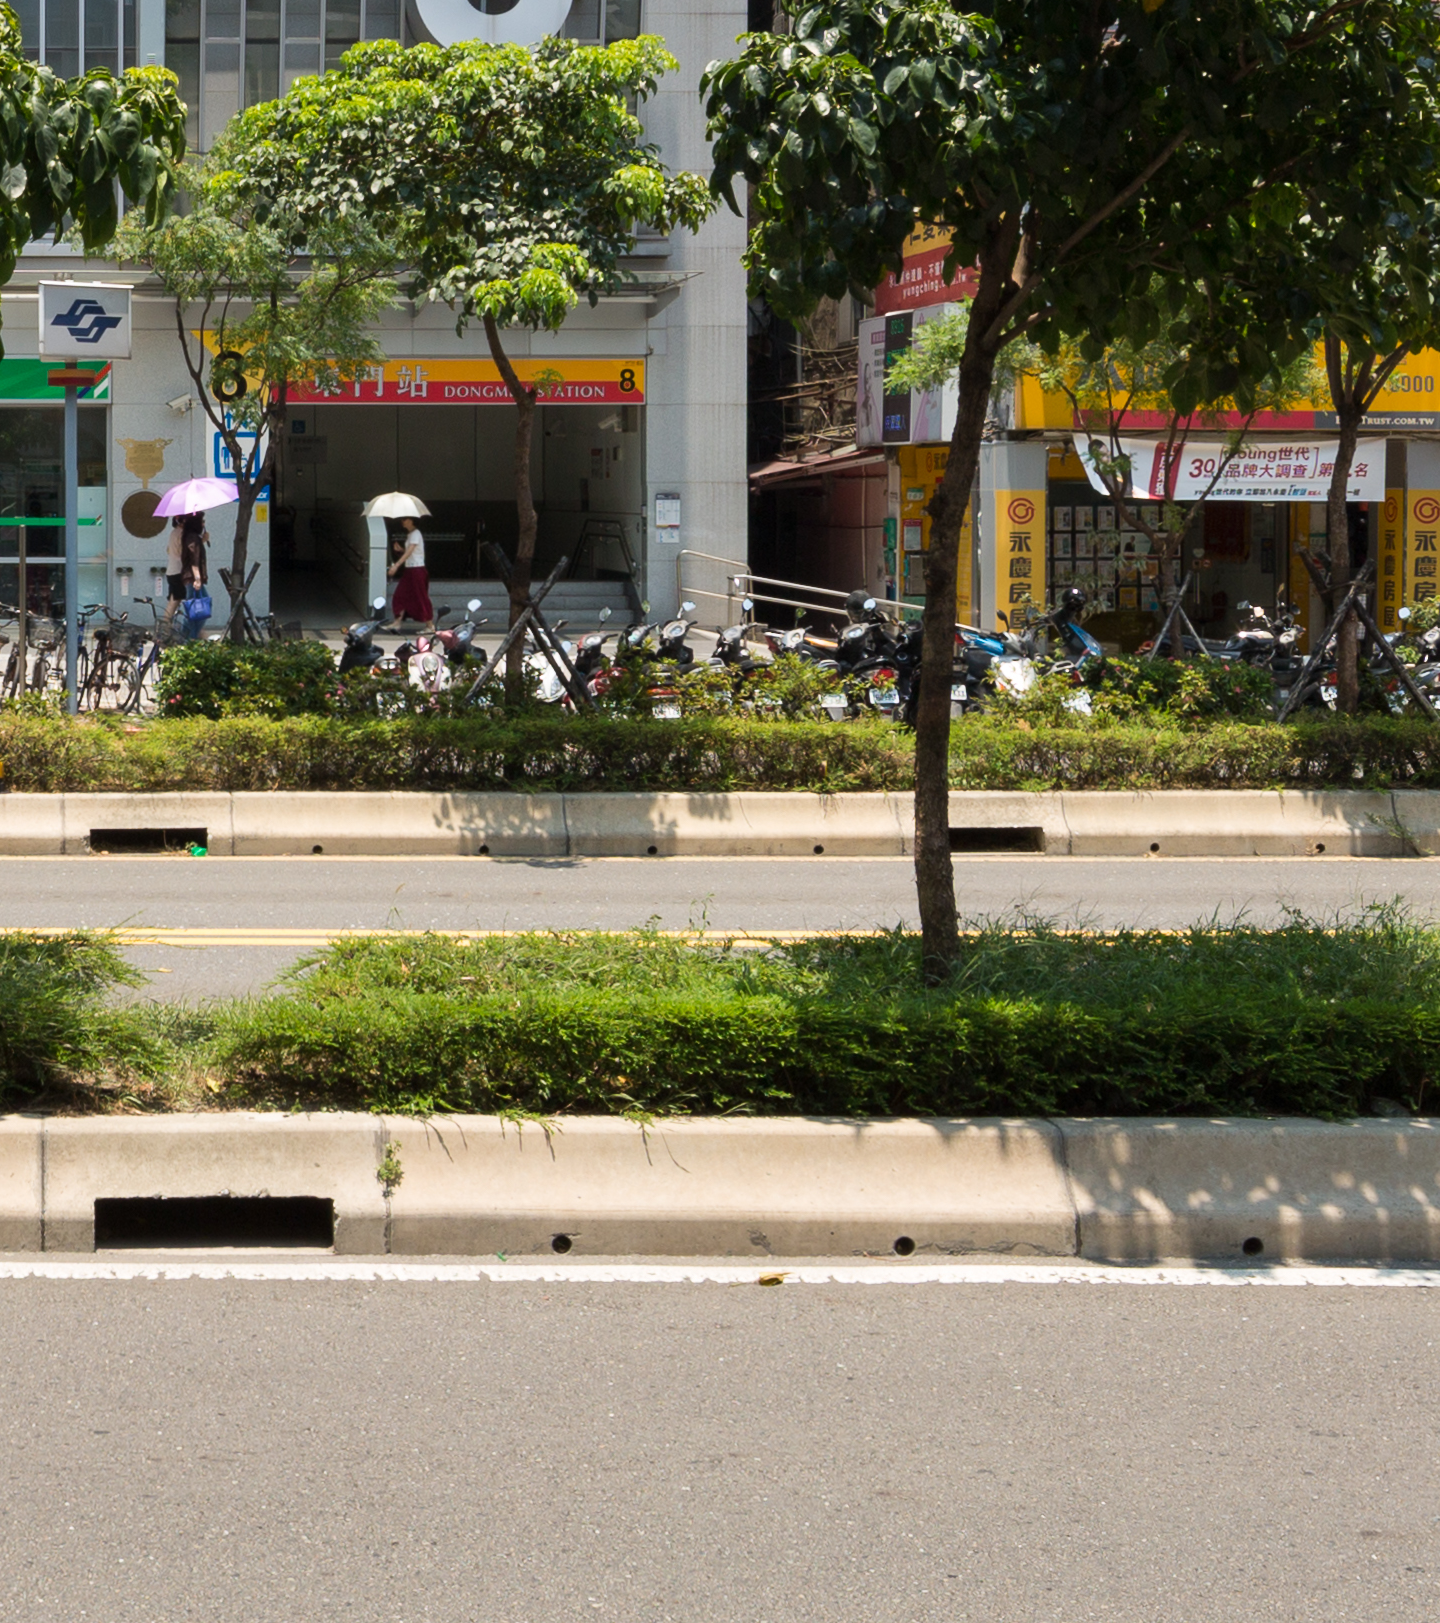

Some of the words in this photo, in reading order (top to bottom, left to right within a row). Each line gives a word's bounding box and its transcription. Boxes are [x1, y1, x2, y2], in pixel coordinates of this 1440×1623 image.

[211, 351, 247, 403] 8
[619, 368, 637, 393] 8
[444, 384, 514, 398] DONGM
[537, 384, 606, 398] STATION
[1189, 458, 1215, 478] 30
